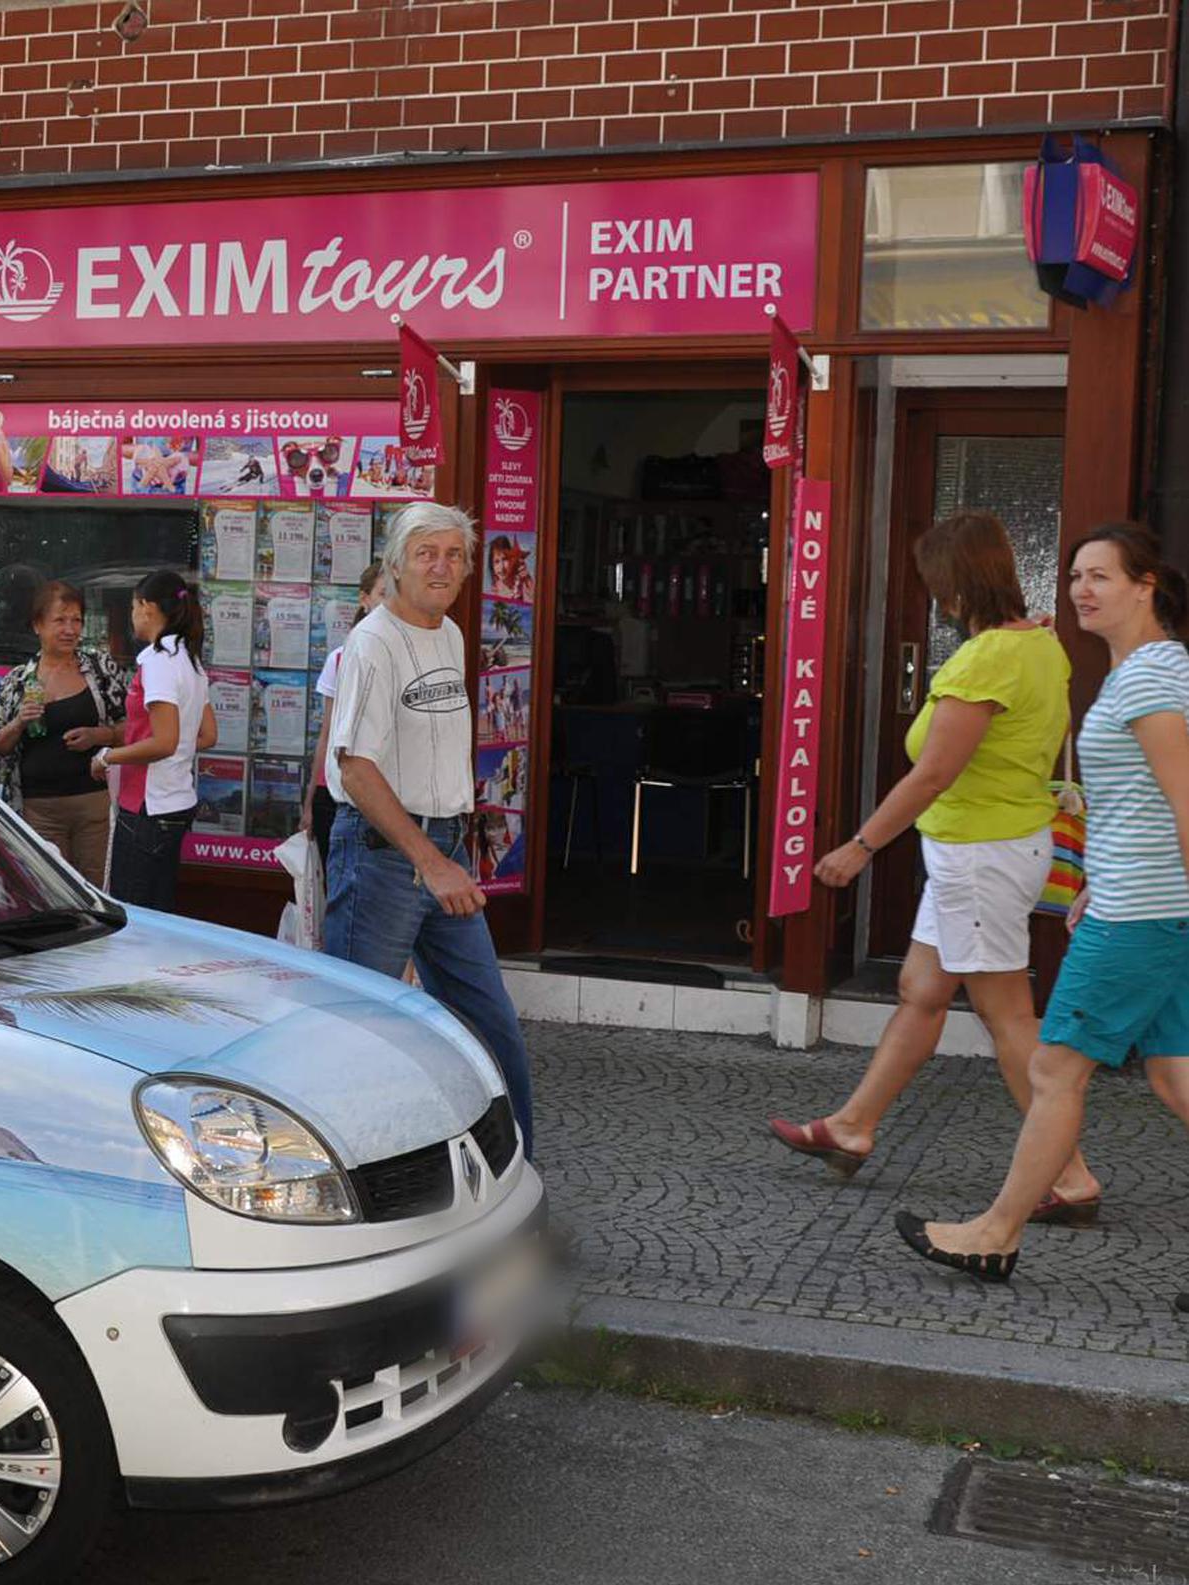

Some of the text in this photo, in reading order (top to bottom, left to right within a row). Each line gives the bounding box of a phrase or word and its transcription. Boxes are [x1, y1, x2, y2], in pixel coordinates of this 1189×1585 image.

[590, 217, 694, 256] EXIM
[588, 261, 783, 302] PARTNER
[47, 409, 329, 432] báječná dovolená s jistotou
[799, 510, 822, 620] NOVÉ
[782, 658, 816, 886] KATALOGY
